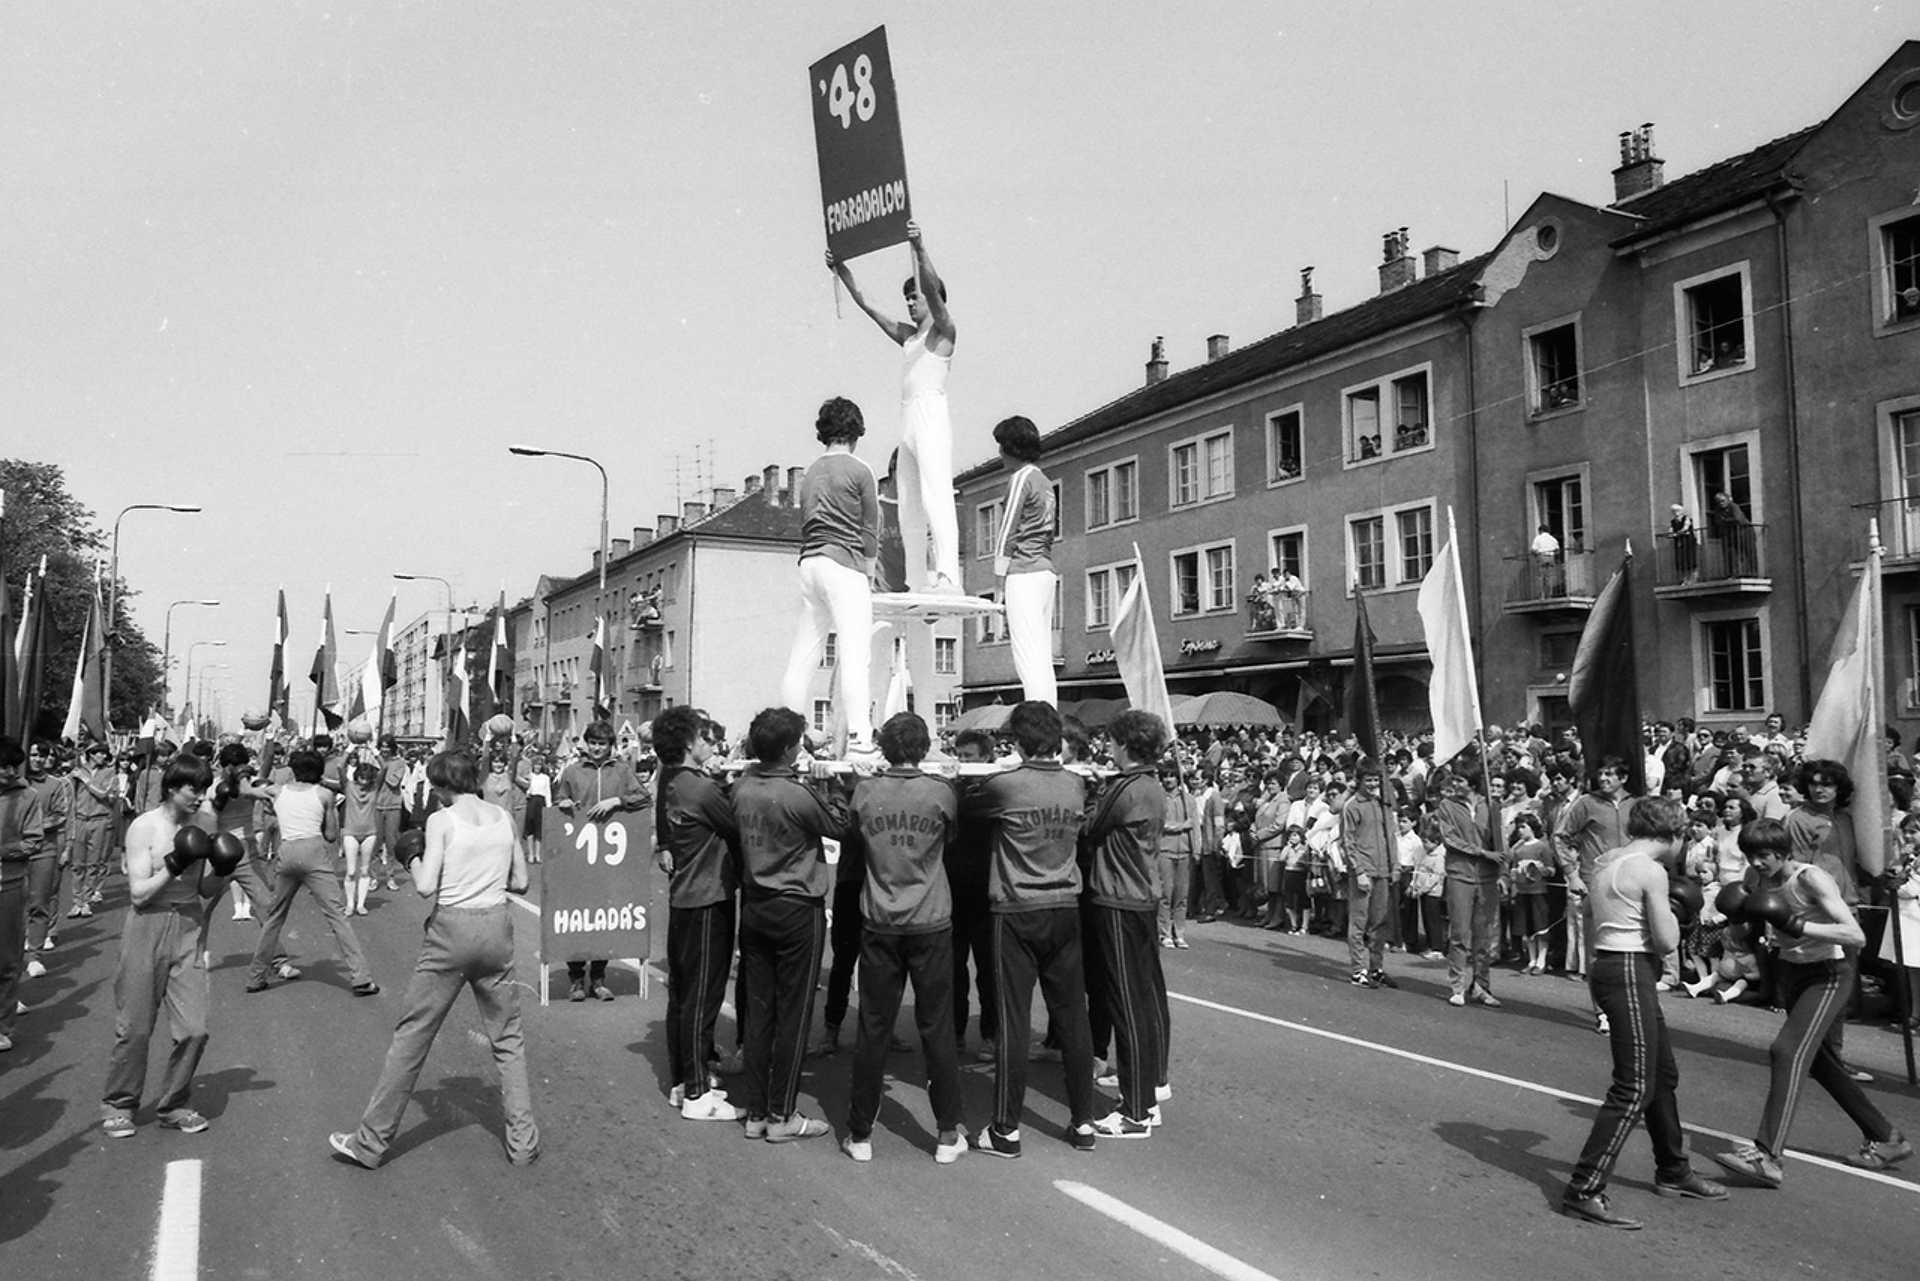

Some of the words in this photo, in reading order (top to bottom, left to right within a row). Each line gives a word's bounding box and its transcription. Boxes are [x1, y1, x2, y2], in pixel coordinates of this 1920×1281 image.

[818, 53, 877, 130] '48
[826, 179, 906, 235] FORRADALOM
[563, 821, 628, 866] '19
[553, 902, 647, 934] HALADÁS
